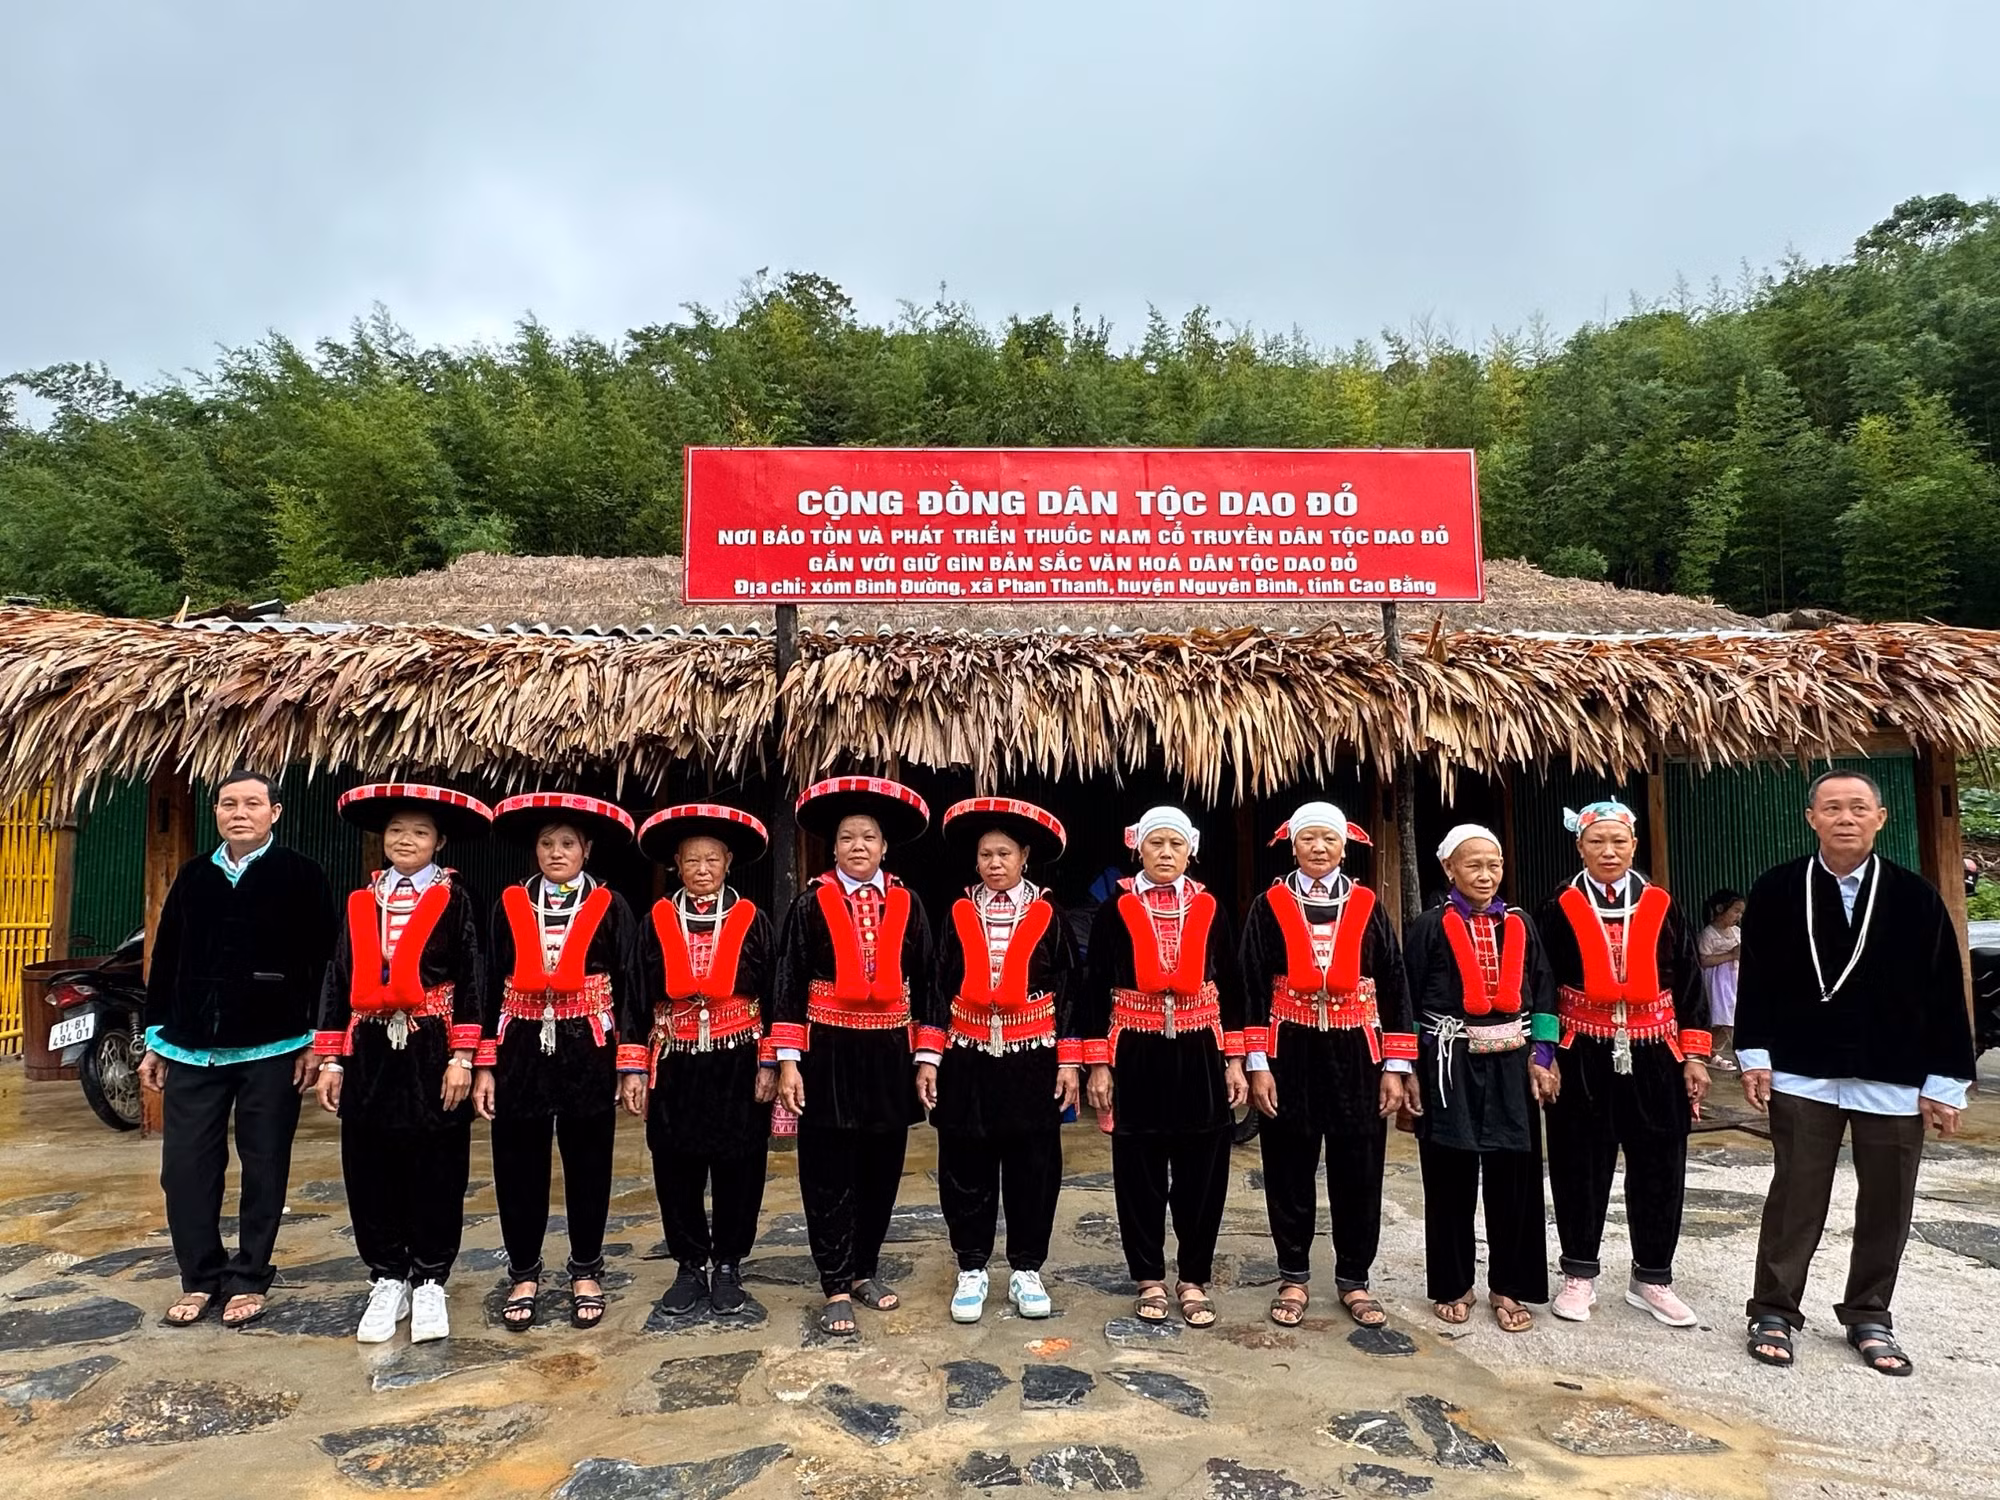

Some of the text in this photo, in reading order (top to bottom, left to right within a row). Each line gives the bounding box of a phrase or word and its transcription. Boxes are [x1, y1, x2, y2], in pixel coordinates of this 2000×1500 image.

[798, 479, 1358, 521] CỘNG ĐỒNG DÂN TỘC DAO ĐỎ
[718, 519, 1449, 548] NƠI BẢO TỒN VÀ PHÁT TRIỂN THUỐC NAM CỔ TRUYỀN DÂN TỘC DAO ĐỎ
[808, 549, 1358, 576] GẮN VỚI GIỮ GÌN BẢN SẮC VĂN HOÁ DÂN TỘC DAO ĐỎ
[733, 574, 1437, 598] Địa chỉ: xóm Bình Đường, xã Phan Thanh, huyện Nguyên Bình, tỉnh Cao Bằng
